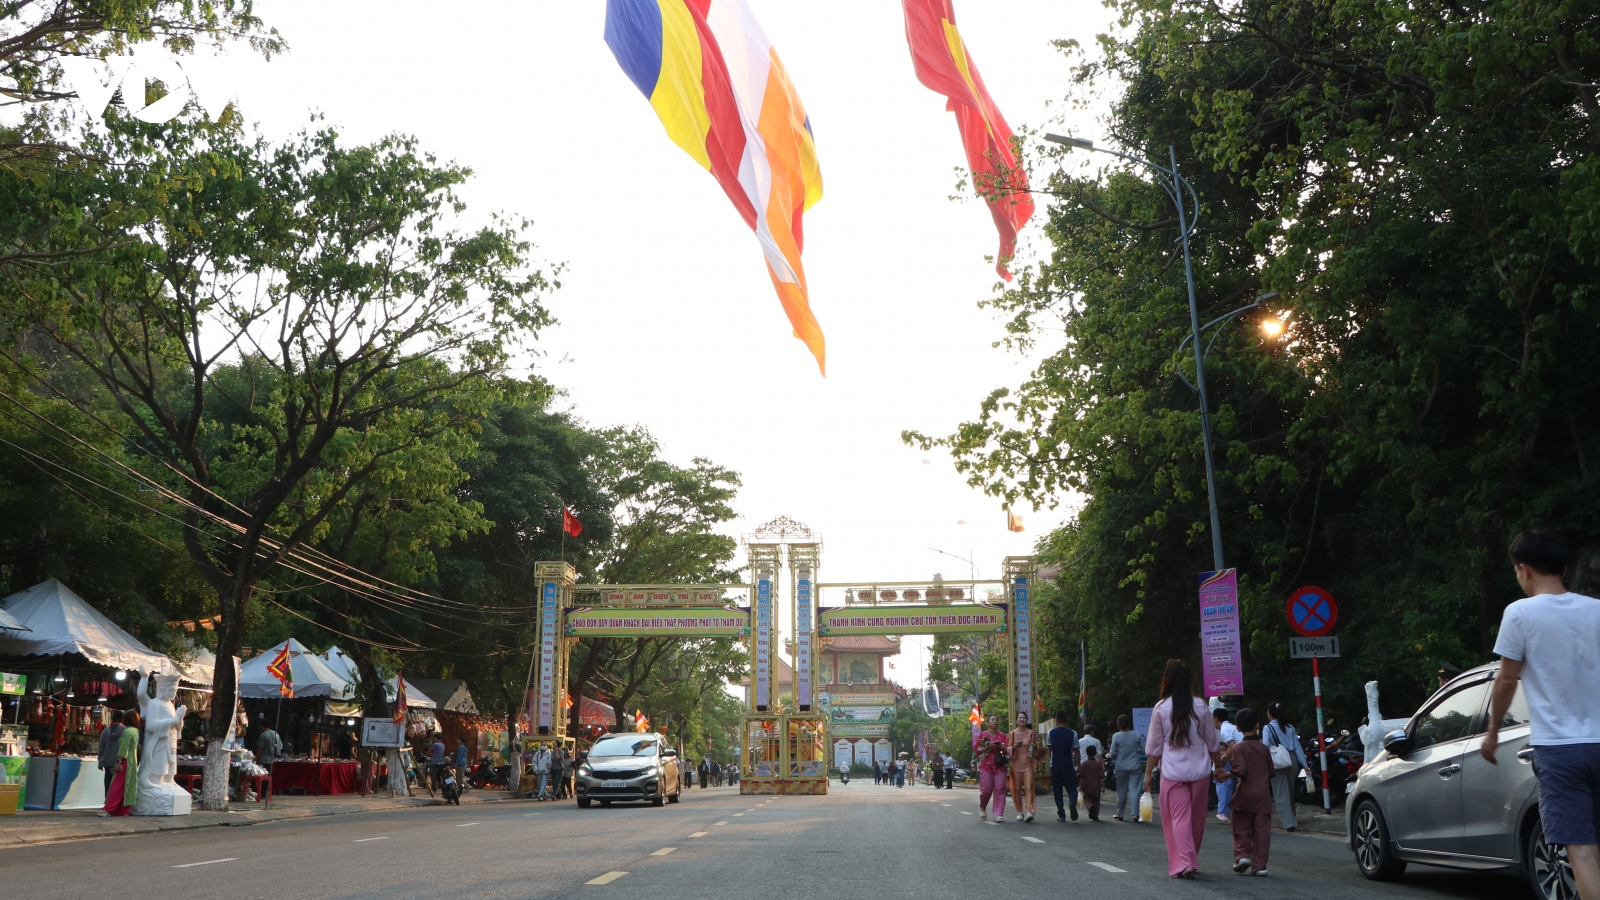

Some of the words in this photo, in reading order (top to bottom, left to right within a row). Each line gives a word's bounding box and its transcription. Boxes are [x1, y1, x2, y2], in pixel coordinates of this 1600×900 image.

[572, 617, 585, 628] CHÀO
[587, 617, 597, 628] ĐÓN
[598, 617, 608, 628] QUÝ
[624, 616, 640, 628] KHÁCH
[642, 618, 650, 630] ĐẠI
[652, 615, 662, 627] BIỂU
[664, 617, 677, 630] THẬP
[678, 617, 698, 627] PHƯƠNG
[699, 616, 712, 629] PHẬT
[720, 618, 734, 627] THAM
[829, 616, 849, 627] THÀNH
[851, 616, 866, 627] KÍNH
[867, 617, 884, 626] CUNG
[886, 617, 909, 626] NGHINH
[911, 616, 923, 625] CHƯ
[925, 614, 936, 625] TÔN
[938, 613, 956, 625] THIỀN
[958, 613, 970, 625] ĐỨC
[972, 614, 988, 624] TĂNG
[990, 615, 997, 624] NI
